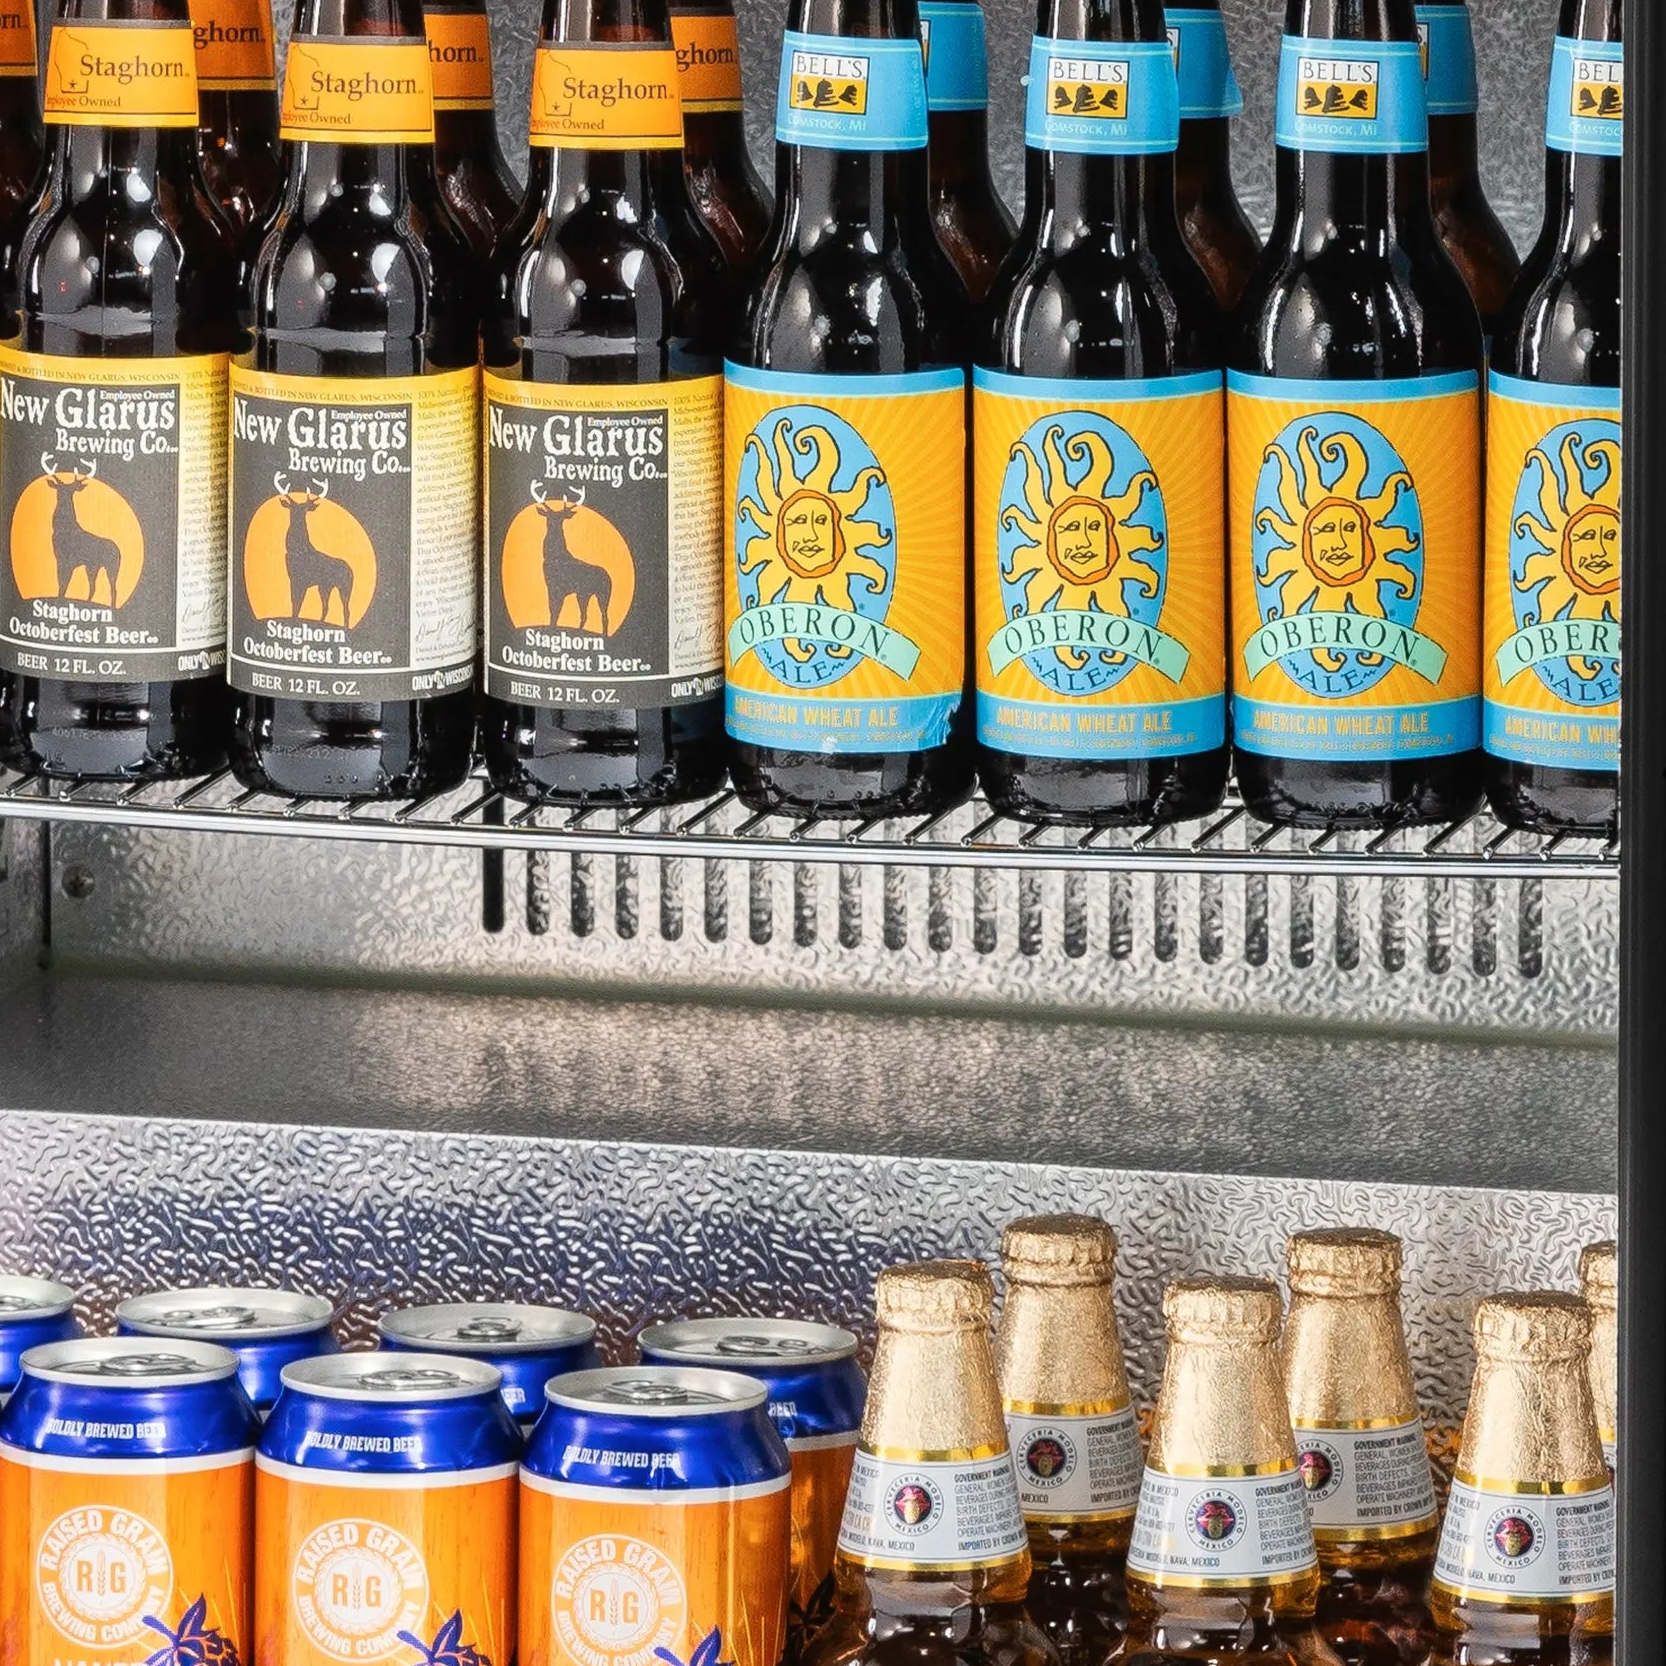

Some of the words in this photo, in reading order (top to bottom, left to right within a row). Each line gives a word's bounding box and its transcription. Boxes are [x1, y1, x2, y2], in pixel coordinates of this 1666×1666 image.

[1579, 62, 1619, 82] BEL
[78, 95, 122, 108] Owned
[309, 112, 352, 125] Owned
[562, 118, 605, 130] Owned
[1112, 123, 1127, 135] MI
[0, 377, 50, 426] New
[55, 387, 175, 431] Glarus
[360, 390, 412, 402] WISCONSIN
[234, 396, 282, 445] New
[287, 406, 407, 450] Glarus
[489, 404, 537, 453] New
[543, 414, 663, 457] Glarus
[587, 416, 629, 428] Employee
[631, 416, 663, 426] Owned
[55, 427, 135, 461] Brewing
[288, 447, 367, 481] Brewing
[544, 456, 624, 488] Brewing
[32, 599, 113, 625] Staghorn
[9, 616, 100, 644] Octoberfest
[266, 619, 346, 643] Staghorn
[525, 629, 604, 653] Staghorn
[739, 606, 891, 656] OBERON
[1004, 612, 1163, 663] OBERON
[1260, 615, 1420, 663] OBERON
[1513, 622, 1620, 664] OBER
[243, 636, 333, 664] Octoberfest
[502, 645, 592, 673] Octoberfest
[771, 658, 832, 684] ALE
[1041, 667, 1105, 691] ALE
[1300, 668, 1364, 694] ALE
[510, 680, 541, 700] BEER
[548, 685, 563, 702] 12
[566, 688, 588, 703] FL.
[591, 688, 620, 704] OZ.
[1253, 710, 1329, 736] AMERICAN
[1335, 715, 1396, 735] WHEAT
[1400, 712, 1429, 733] ALE
[343, 1435, 391, 1453] BREWED
[40, 1509, 103, 1571] RAISED
[109, 1512, 168, 1576] GRAIN
[888, 1540, 915, 1551] MEXICO
[958, 1537, 993, 1551] IMPORTED
[993, 1536, 1001, 1547] BY
[1487, 1572, 1516, 1584] MEXICO
